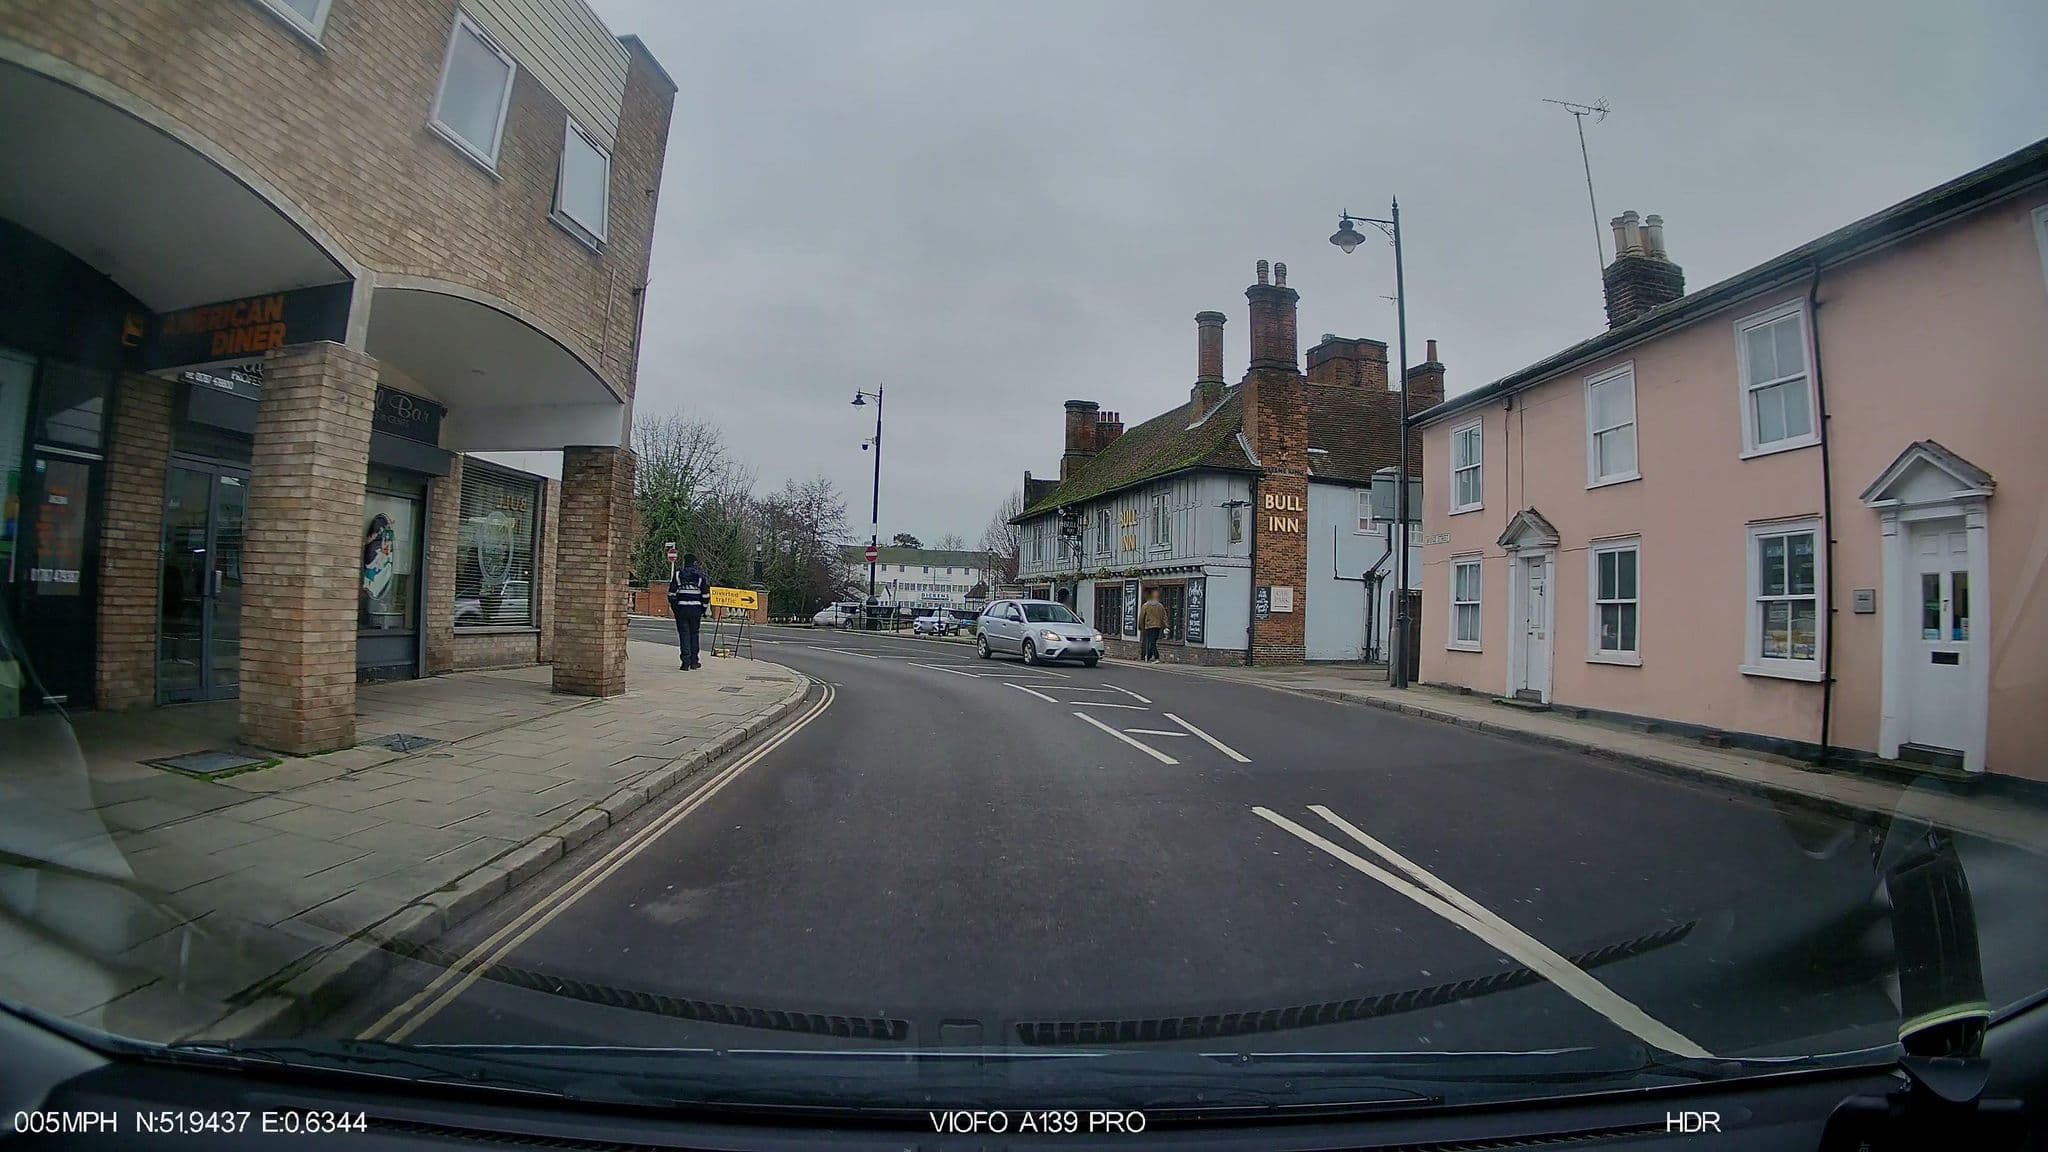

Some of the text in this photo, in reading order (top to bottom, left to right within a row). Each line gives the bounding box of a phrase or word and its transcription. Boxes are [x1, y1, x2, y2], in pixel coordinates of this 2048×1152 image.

[211, 322, 287, 357] DINER
[389, 394, 431, 425] Bar
[1265, 494, 1303, 511] BULL
[1120, 510, 1137, 527] BULL
[1269, 516, 1299, 533] INN
[1121, 535, 1136, 551] INN
[711, 590, 739, 598] Diverted
